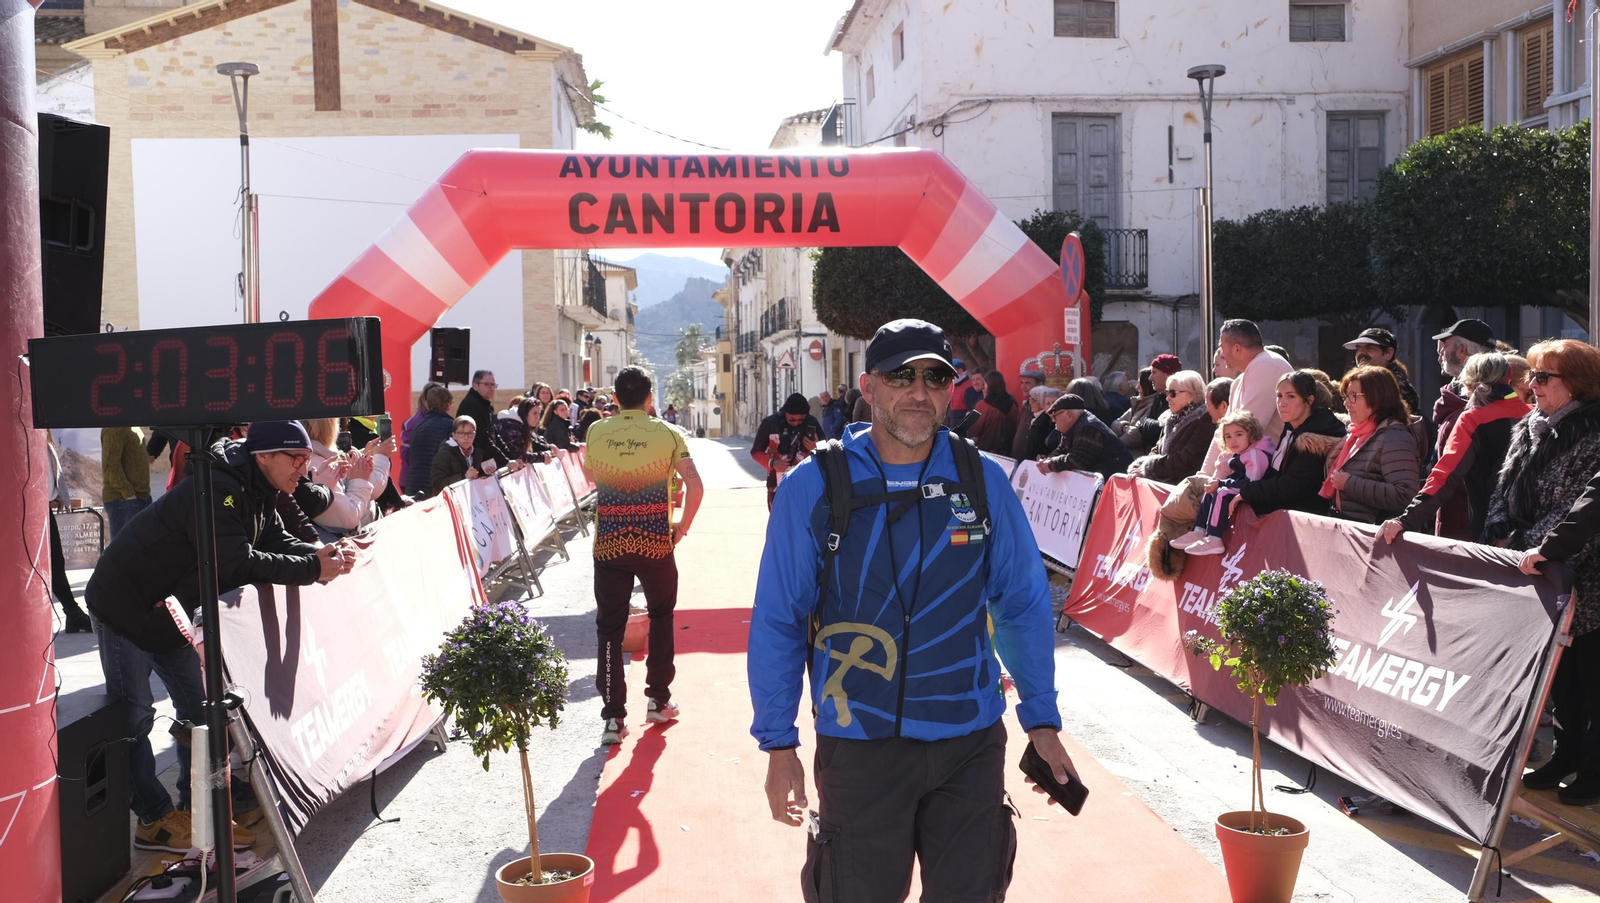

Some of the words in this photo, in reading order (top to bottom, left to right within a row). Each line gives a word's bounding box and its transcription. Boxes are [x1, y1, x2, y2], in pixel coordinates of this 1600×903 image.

[559, 154, 850, 178] AYUNTAMIENTO
[567, 192, 841, 235] CANTORIA
[90, 329, 357, 417] 2:03:06
[606, 438, 625, 449] Pepe
[626, 438, 648, 450] Yepes
[1078, 499, 1088, 513] DE
[290, 669, 373, 769] TEAMERGY
[1324, 696, 1403, 740] www.teamergy.es
